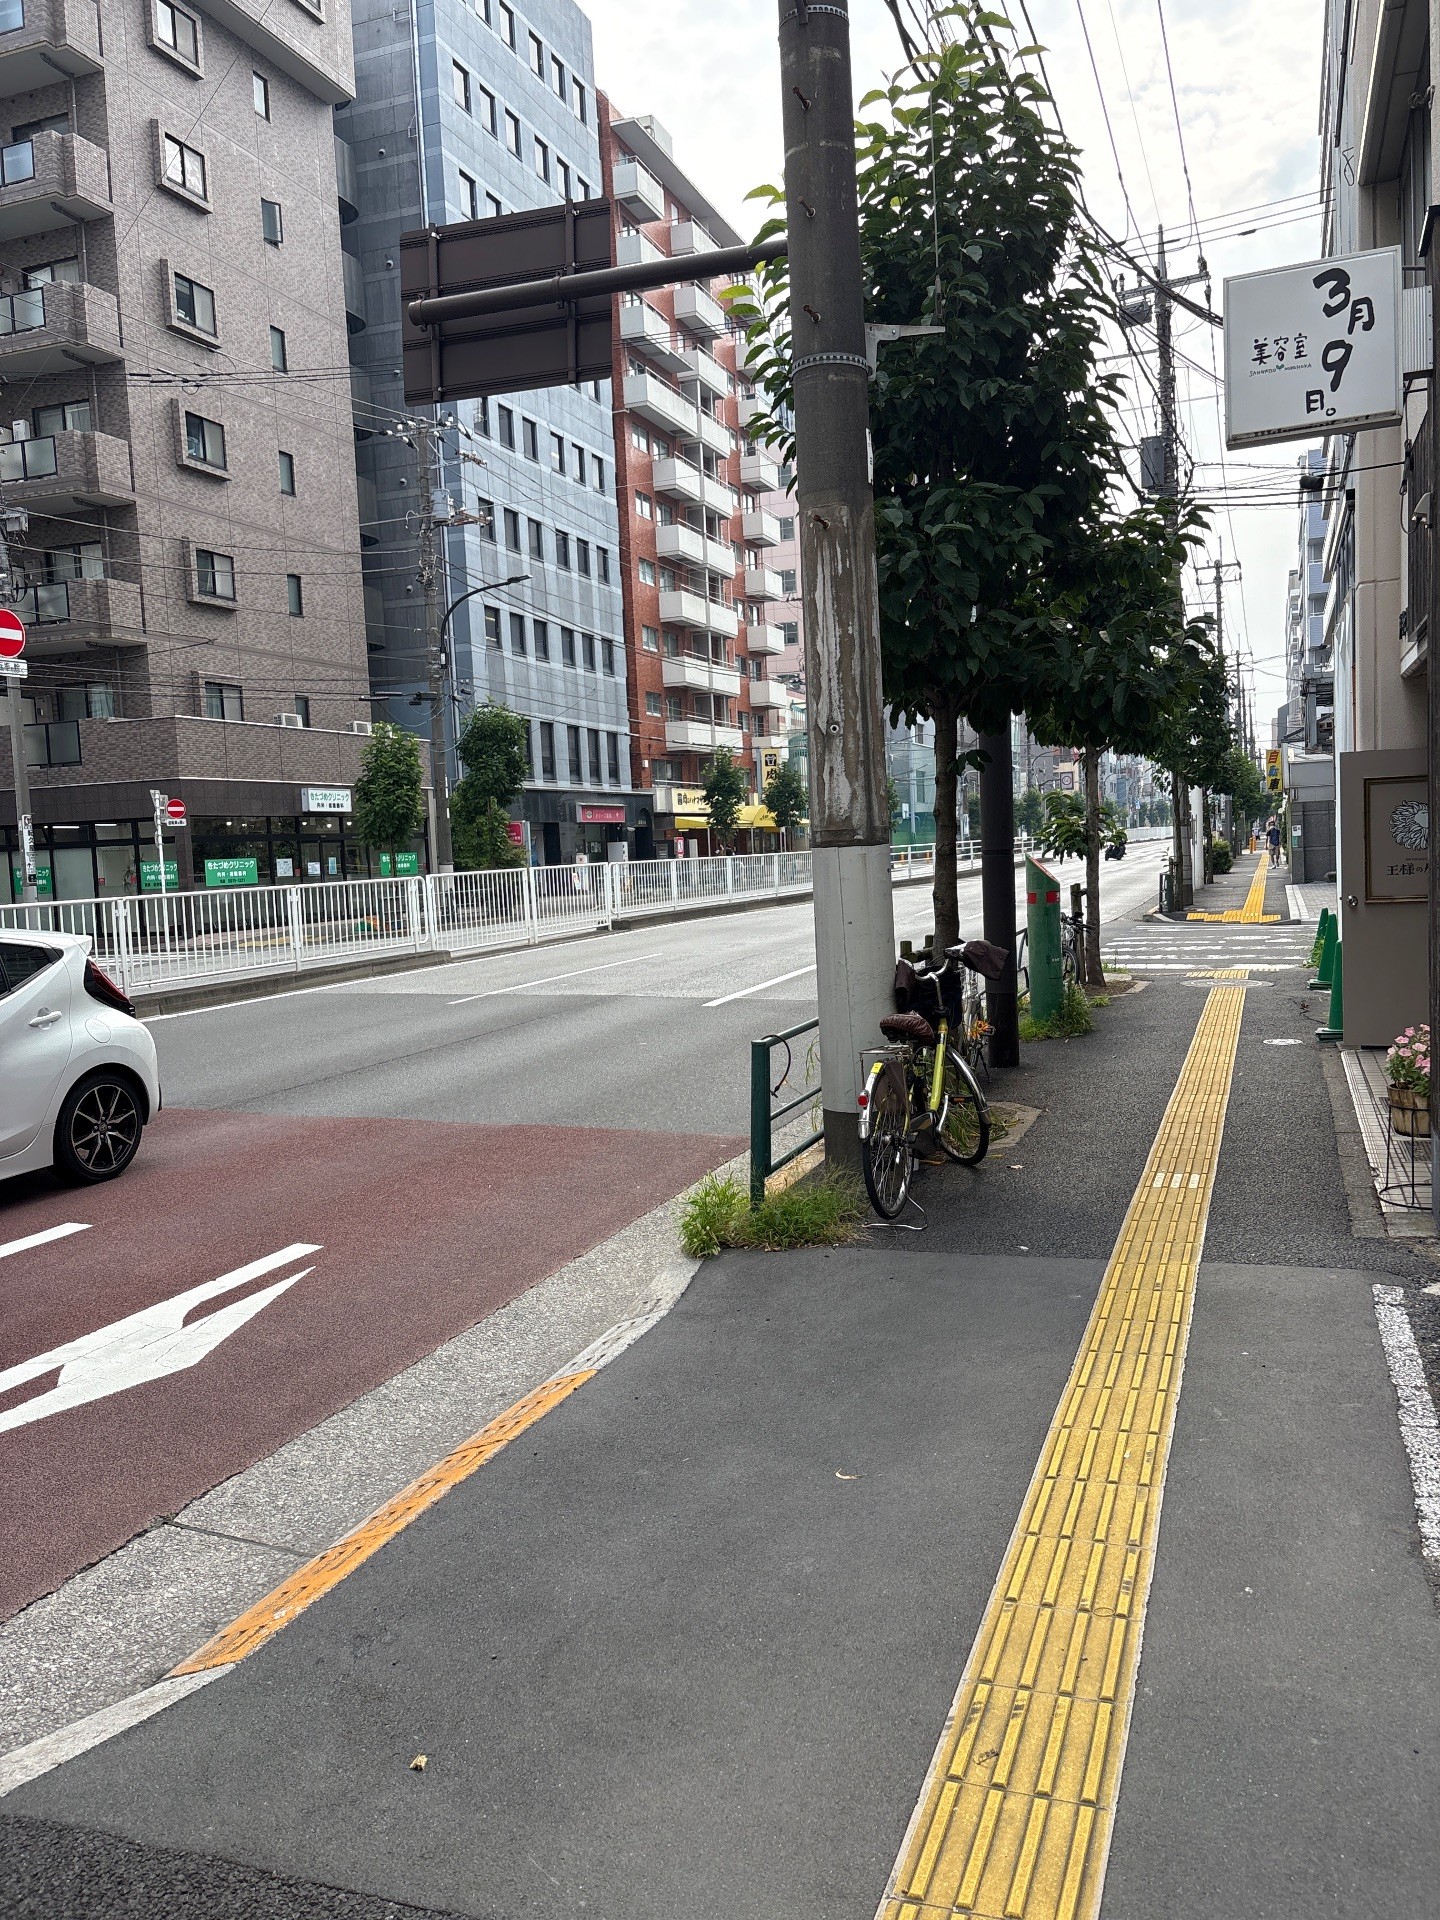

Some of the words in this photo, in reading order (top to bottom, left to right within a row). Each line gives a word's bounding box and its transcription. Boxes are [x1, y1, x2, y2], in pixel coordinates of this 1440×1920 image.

[1251, 332, 1309, 366] 美容室
[1268, 750, 1281, 791] 自転車
[310, 791, 350, 802] きたづめクリニック
[142, 863, 177, 873] きたづめクニック
[207, 860, 254, 870] きたづめクリニック
[1387, 862, 1429, 876] 王様の
